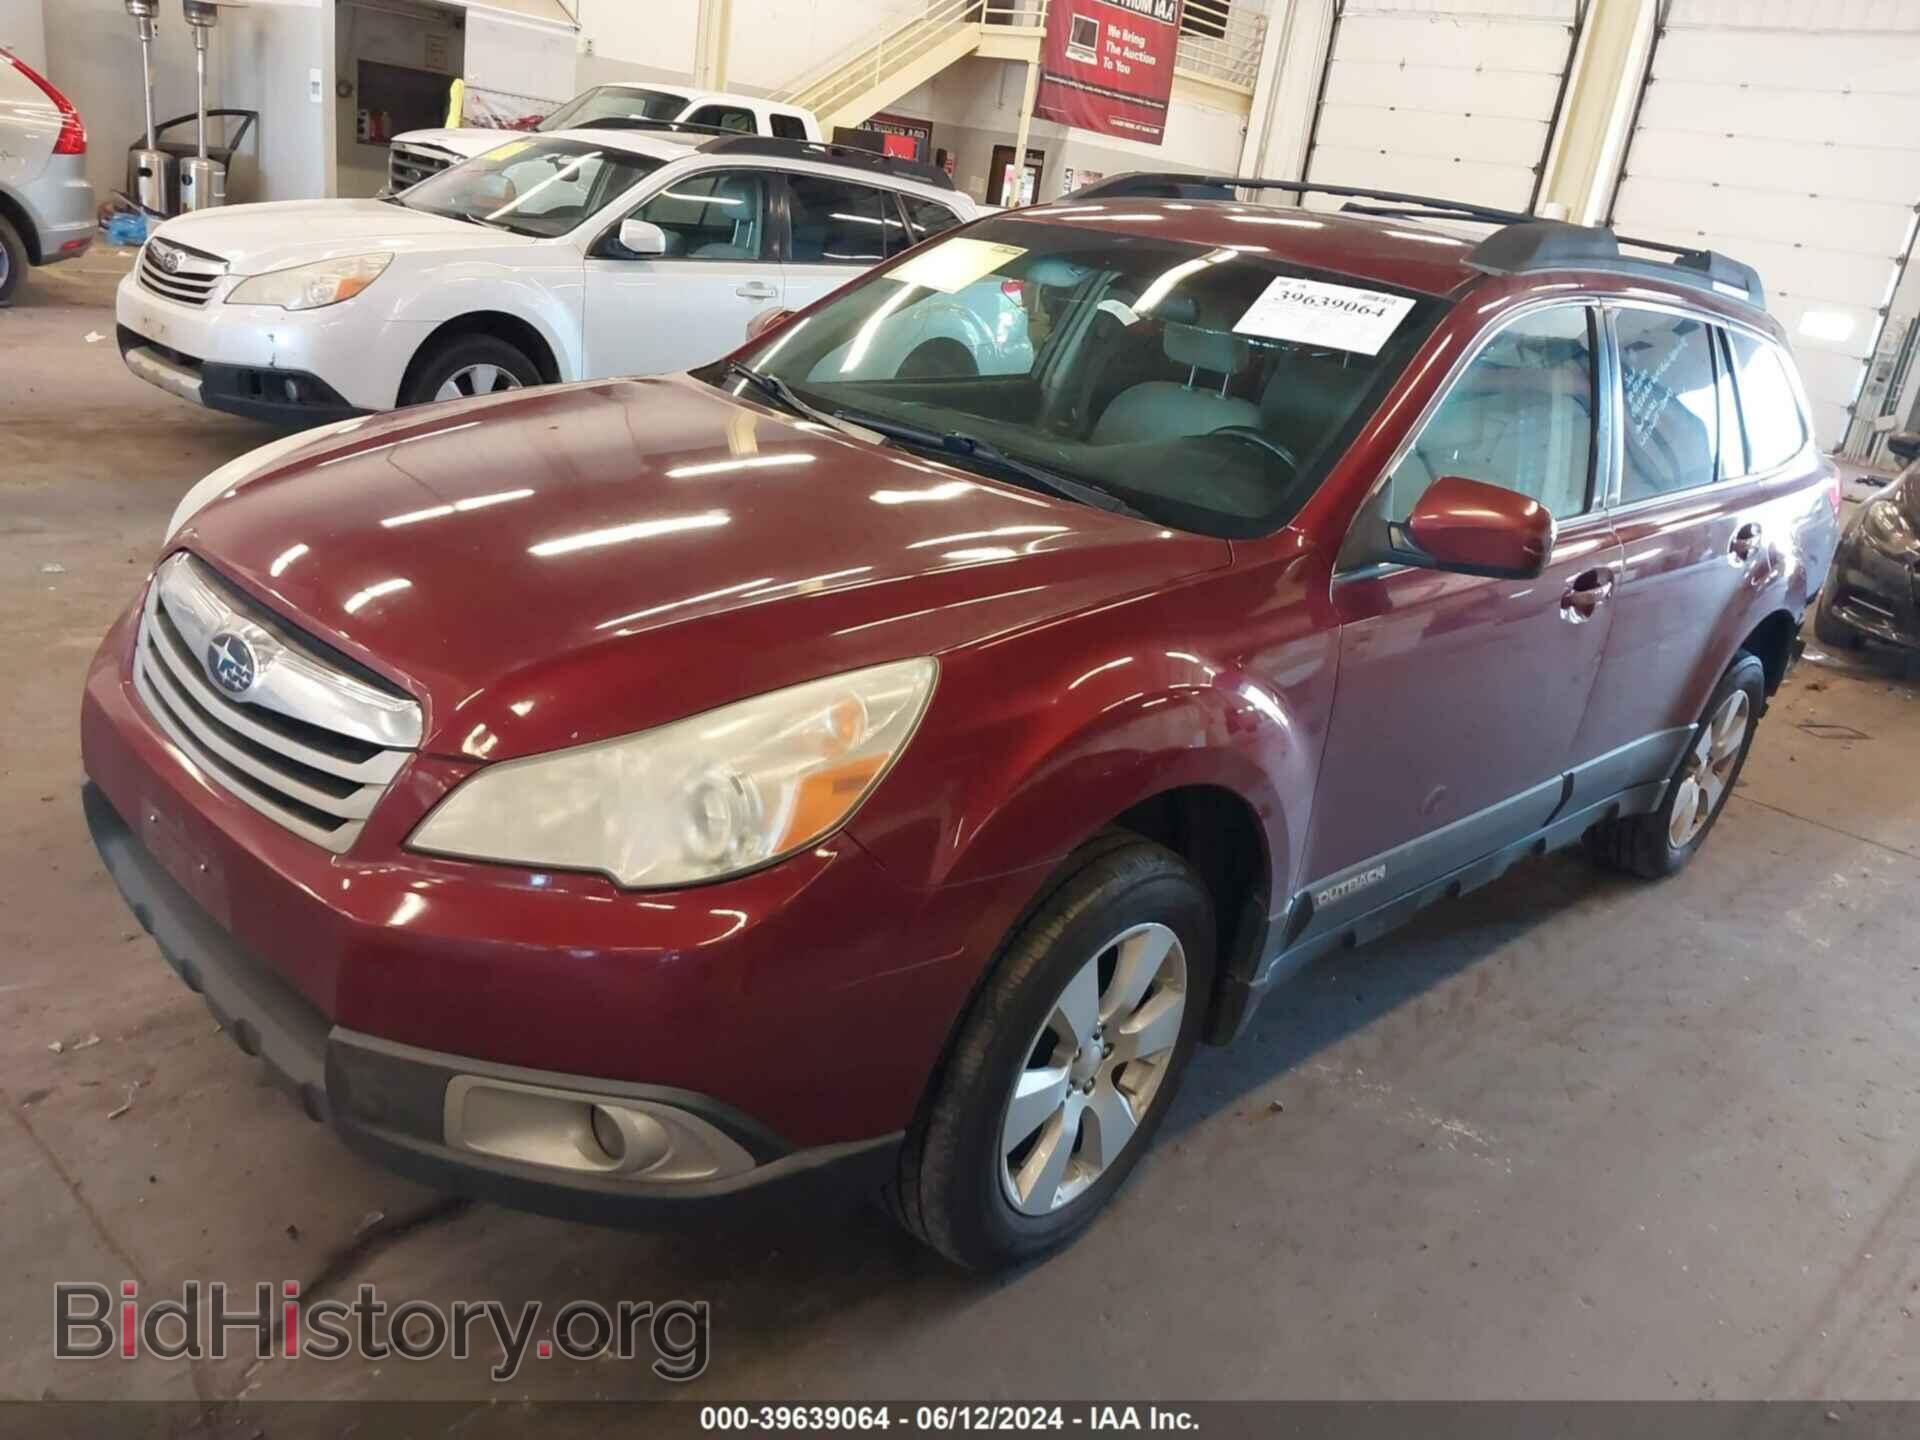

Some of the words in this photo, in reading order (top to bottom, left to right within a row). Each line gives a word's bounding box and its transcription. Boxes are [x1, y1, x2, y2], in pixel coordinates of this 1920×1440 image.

[1107, 24, 1121, 39] We
[1122, 29, 1146, 49] Bring
[1106, 40, 1121, 55] The
[1122, 46, 1156, 65] Auction
[1103, 56, 1113, 70] To
[1115, 59, 1130, 75] You
[1274, 289, 1387, 318] 39639064
[1316, 865, 1387, 906] OUTBACK
